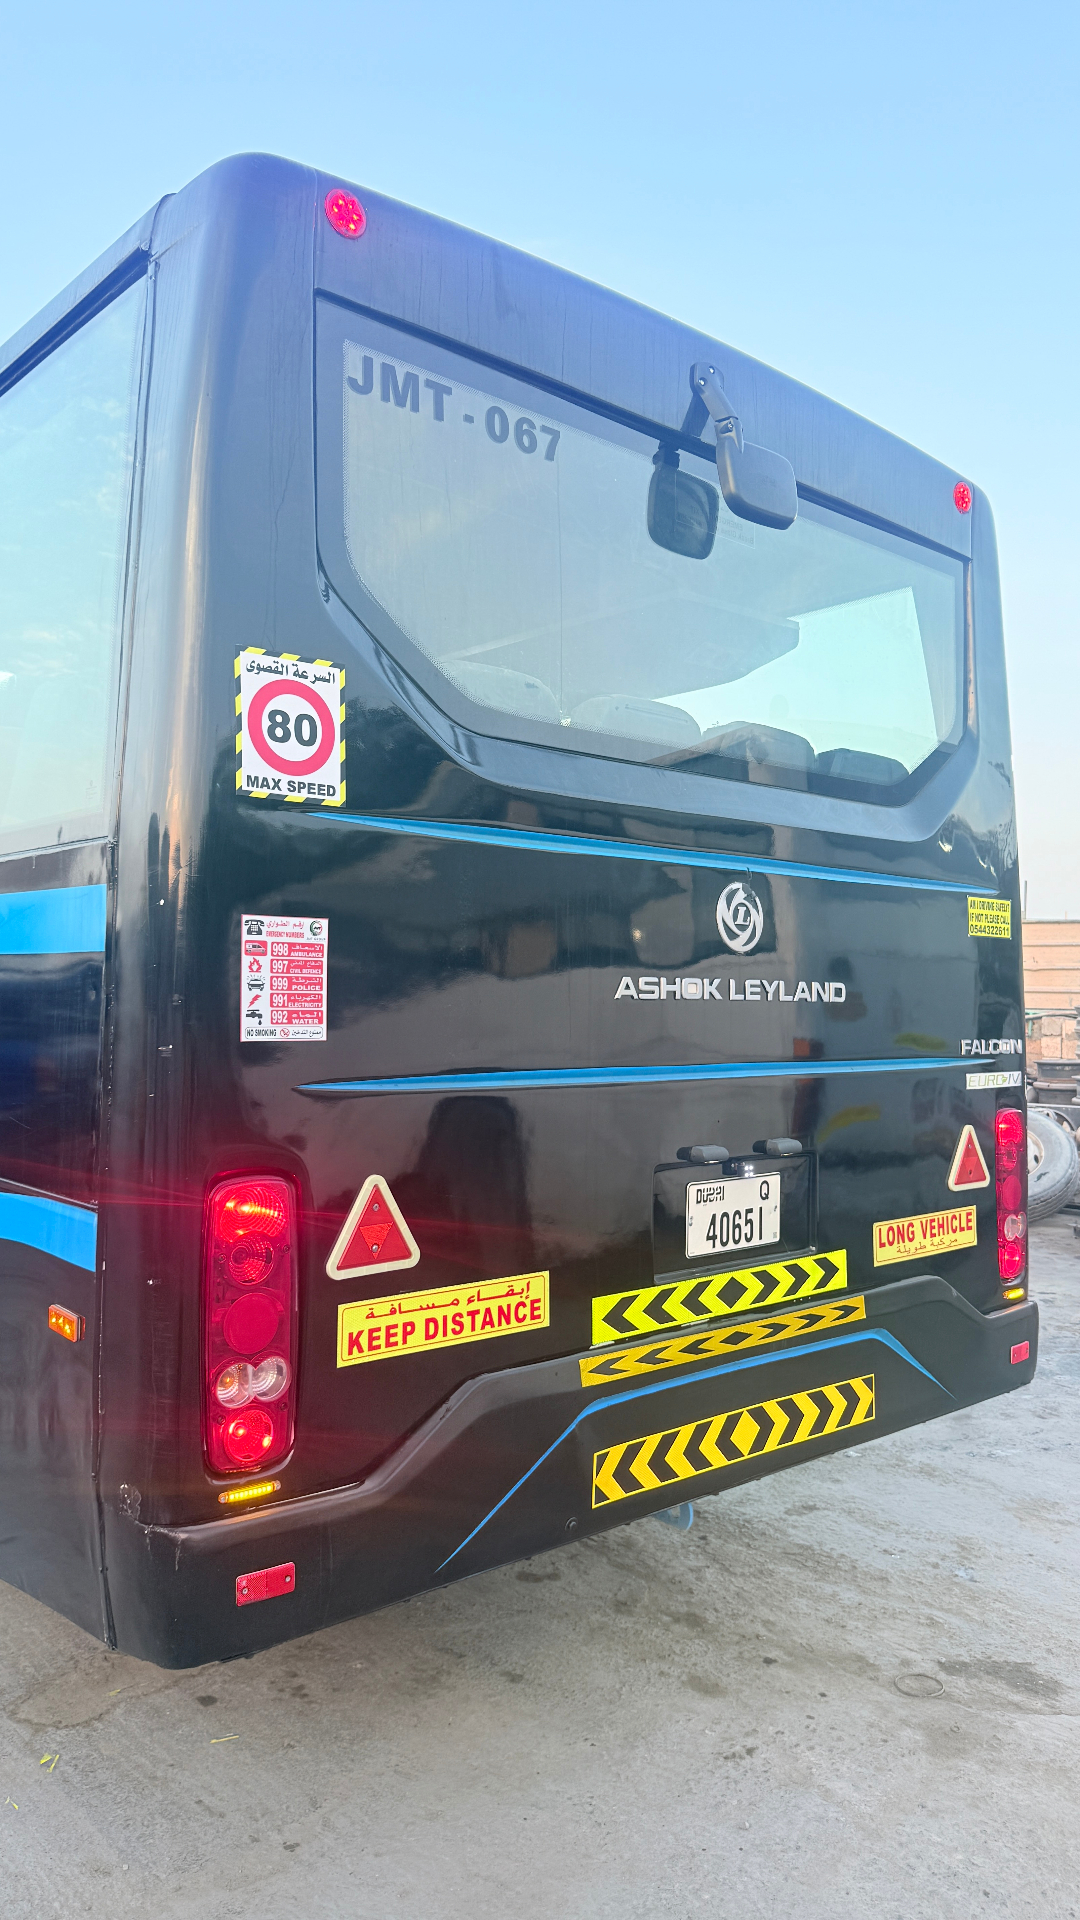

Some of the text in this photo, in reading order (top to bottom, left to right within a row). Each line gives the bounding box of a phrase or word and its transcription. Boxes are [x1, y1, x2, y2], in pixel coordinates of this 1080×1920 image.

[347, 354, 453, 423] JMT
[484, 405, 561, 462] 067
[245, 659, 336, 685] السرعة القصوى
[267, 709, 318, 747] 80
[246, 774, 337, 798] MAX SPEED
[970, 899, 976, 910] AM
[979, 900, 995, 911] DRIVING
[995, 902, 1010, 913] SAFELY?
[970, 912, 1010, 925] IF NOT PLEASE CALL
[969, 924, 1010, 936] 0544322611
[272, 943, 289, 956] 998
[272, 960, 289, 973] 997
[272, 977, 288, 990] 999
[291, 976, 322, 985] الشرطة
[614, 976, 847, 1003] ASHOK LEYLAND
[272, 994, 288, 1007] 991
[271, 1011, 288, 1024] 992
[246, 1029, 277, 1037] NO SMOKING
[960, 1039, 1023, 1055] FALCON
[760, 1180, 770, 1201] Q
[706, 1206, 763, 1249] 40651
[879, 1212, 973, 1249] LONG VEHICLE
[896, 1237, 958, 1254] مركبة طويلة
[365, 1280, 531, 1320] إبقاء مسافة
[347, 1298, 542, 1356] KEEP DISTANCE
